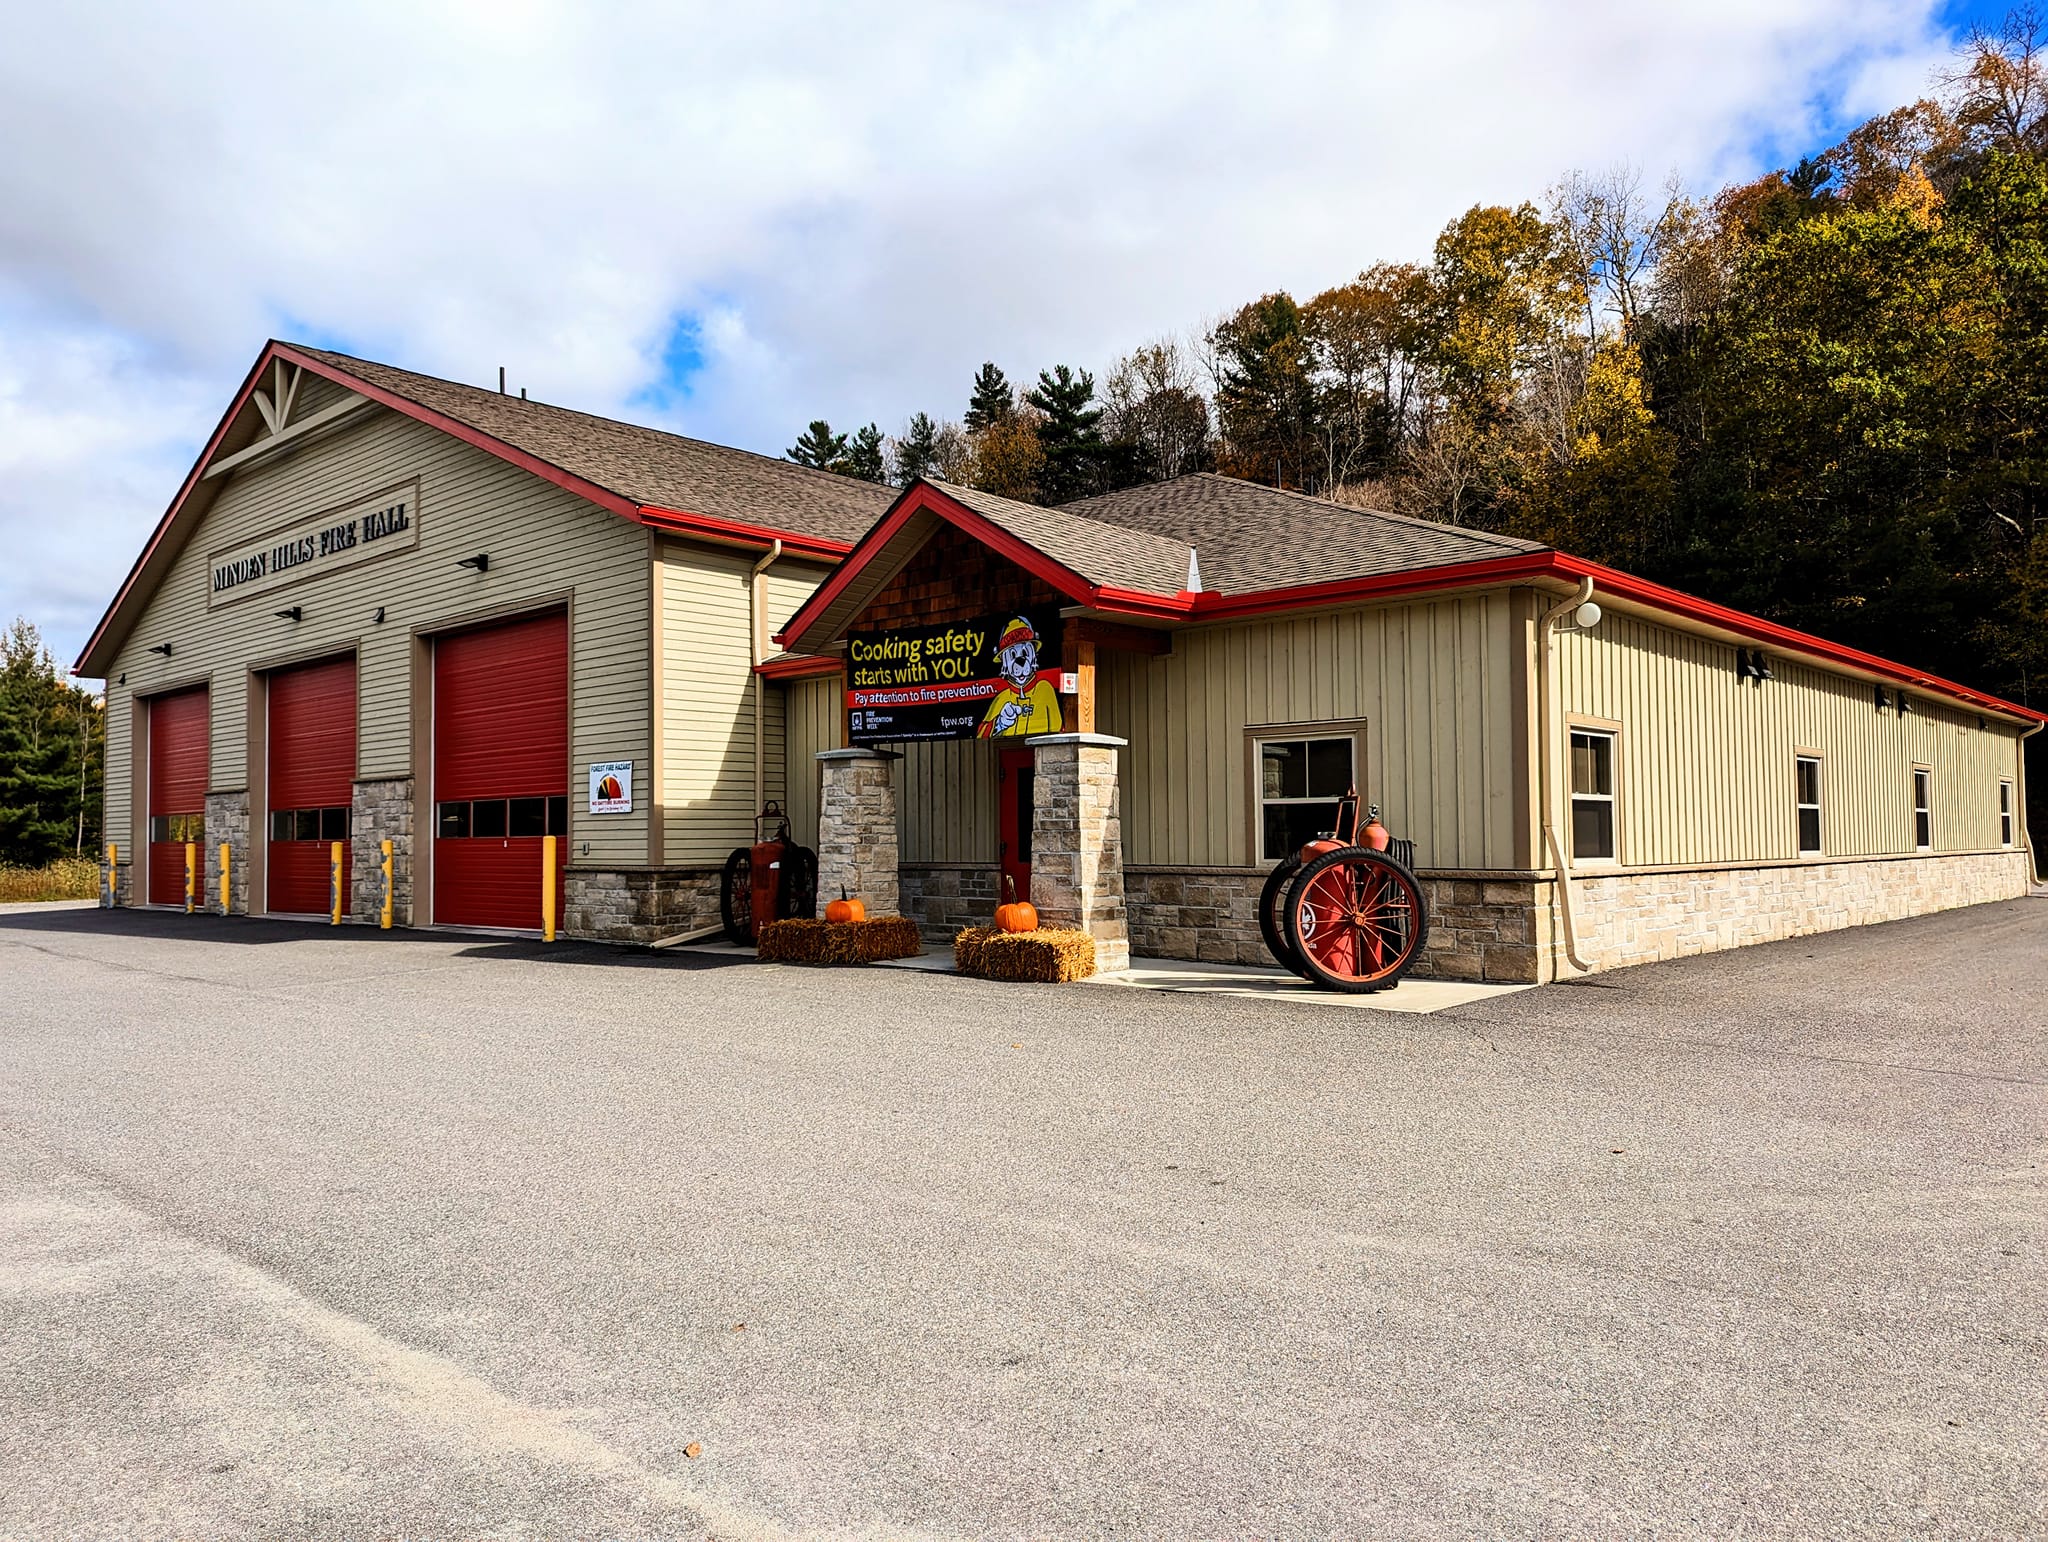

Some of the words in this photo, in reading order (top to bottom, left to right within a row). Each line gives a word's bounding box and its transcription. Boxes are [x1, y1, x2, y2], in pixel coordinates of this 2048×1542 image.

[213, 552, 266, 592] MINDEN
[271, 535, 315, 573] HILLS
[319, 520, 357, 557] FIRE
[362, 503, 410, 543] HALL
[851, 636, 922, 663] Cooking
[925, 629, 985, 657] safety
[854, 667, 892, 686] starts
[894, 662, 928, 683] with
[931, 656, 975, 680] YOU.
[855, 692, 868, 707] Pay
[869, 691, 909, 704] attention
[910, 690, 919, 702] to
[920, 688, 936, 701] fire
[937, 683, 998, 703] prevention.
[940, 715, 974, 728] fpw.org
